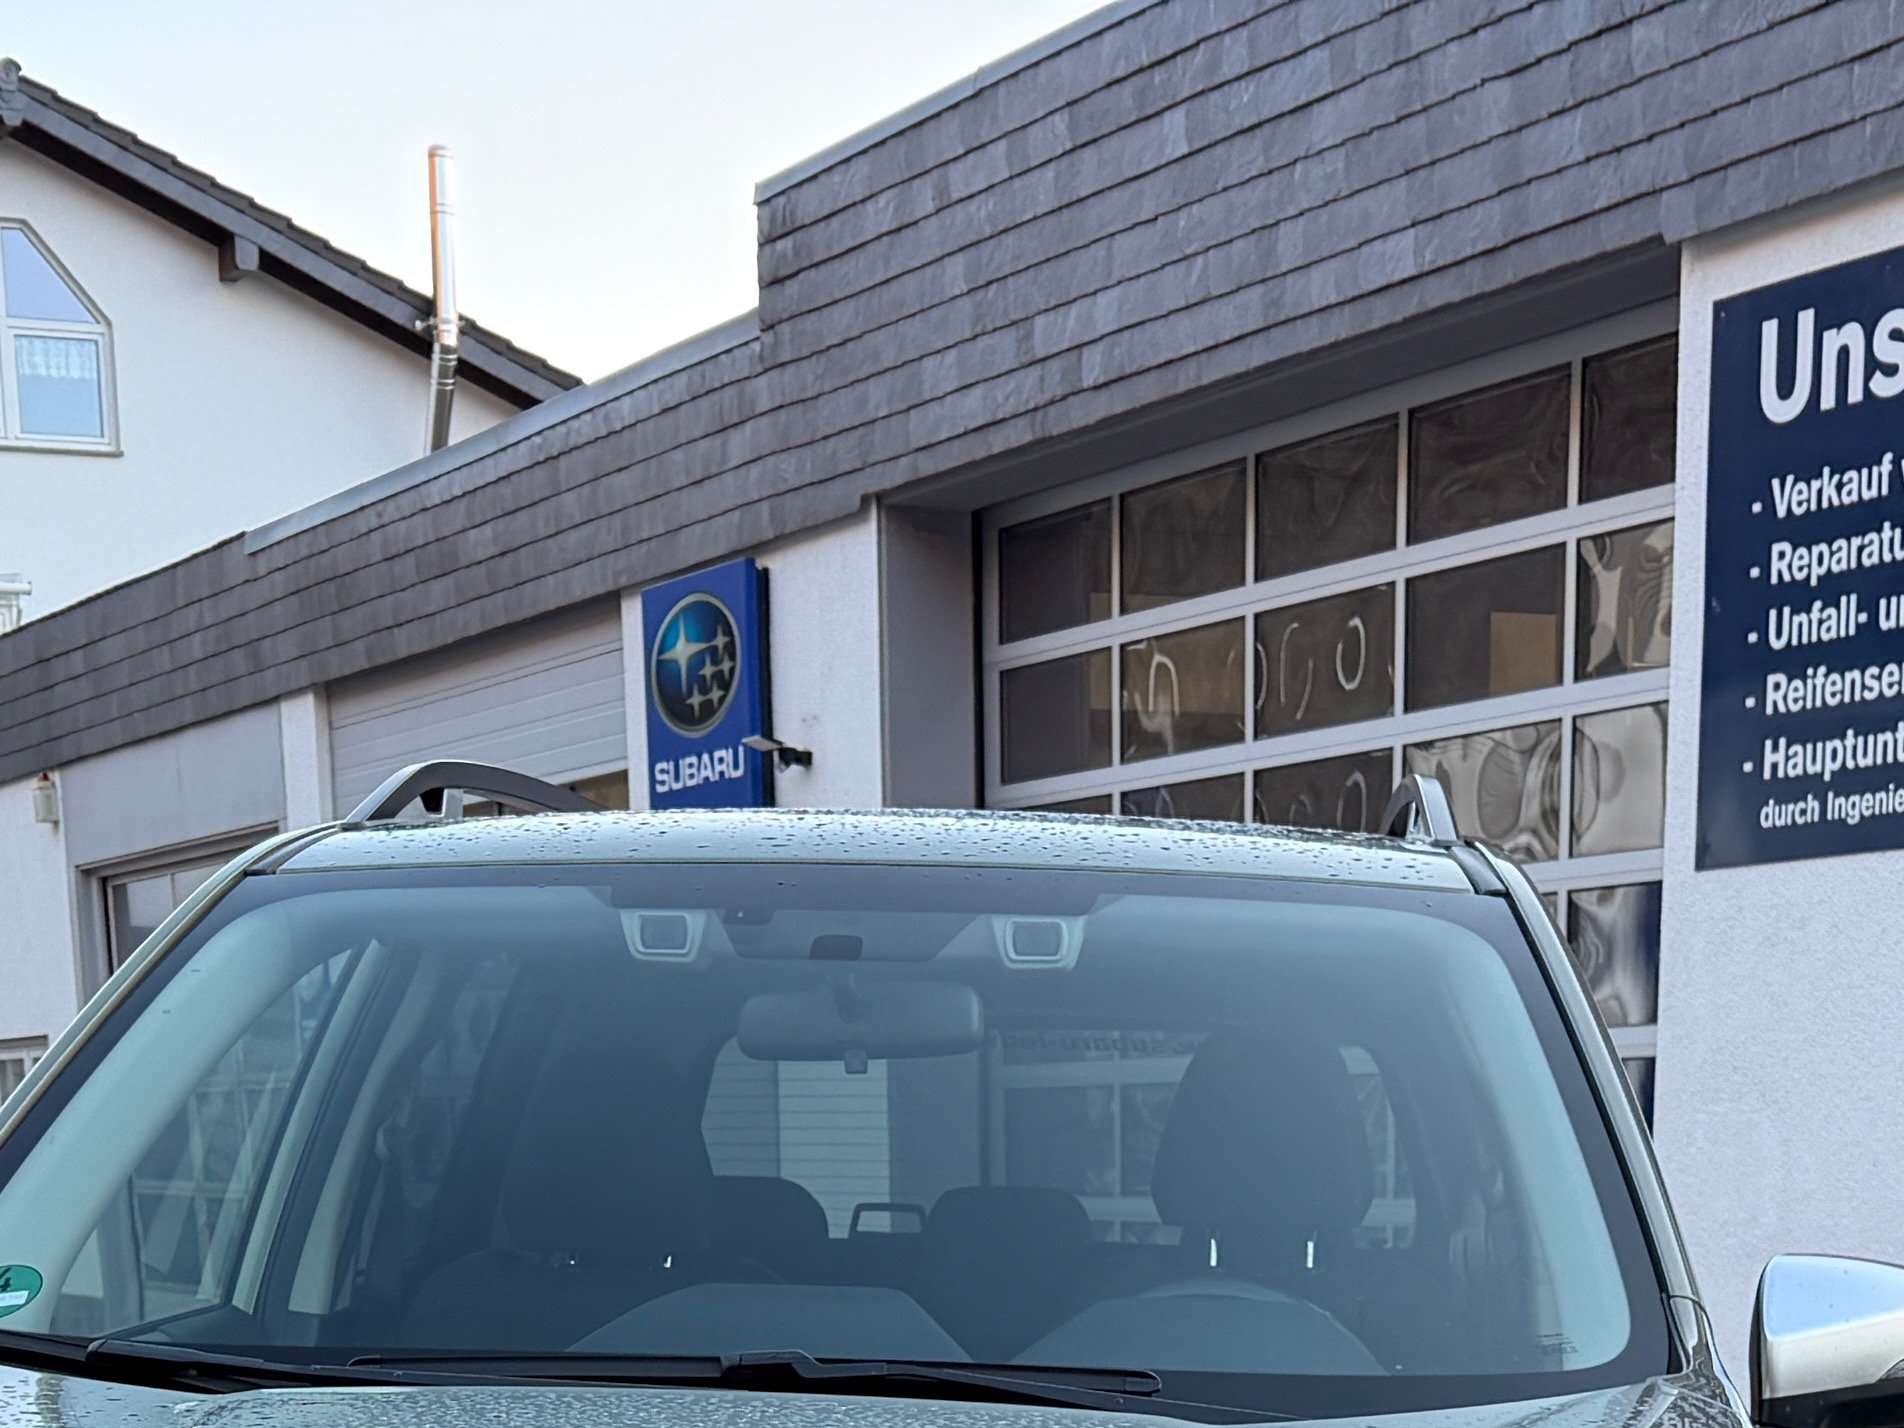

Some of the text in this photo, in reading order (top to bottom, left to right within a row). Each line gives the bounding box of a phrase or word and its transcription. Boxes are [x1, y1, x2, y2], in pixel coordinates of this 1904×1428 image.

[1770, 451, 1894, 519] Verkauf
[1767, 593, 1869, 651] Unfall-
[654, 745, 745, 794] SUBARU
[1760, 792, 1821, 829] durch
